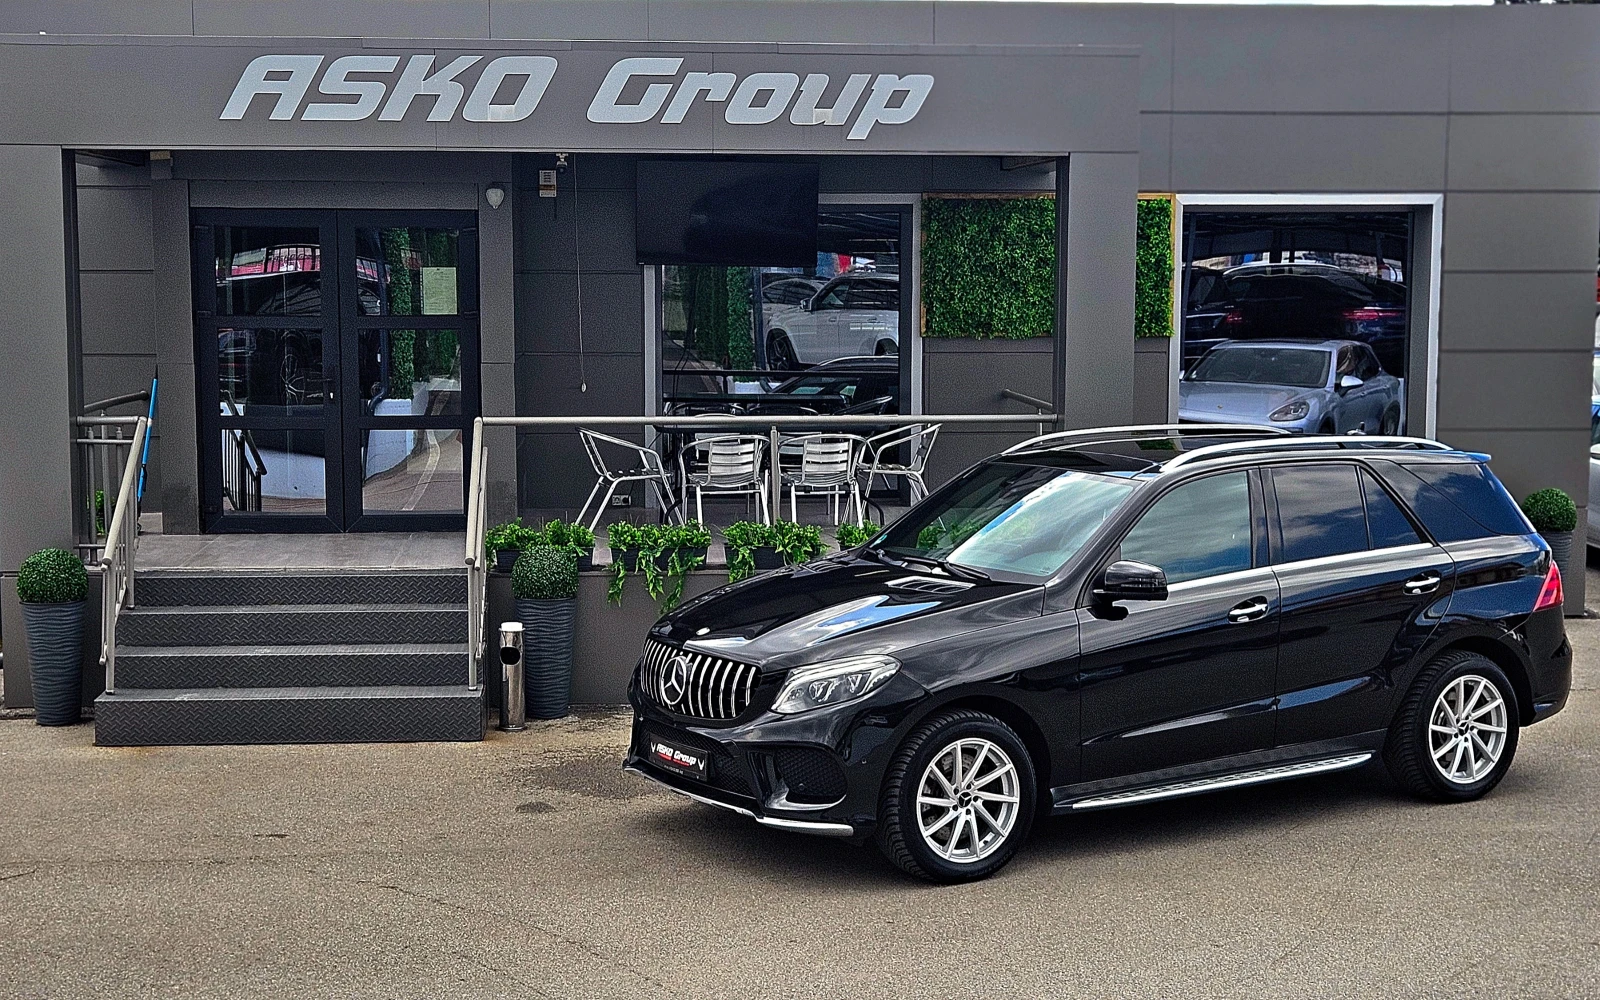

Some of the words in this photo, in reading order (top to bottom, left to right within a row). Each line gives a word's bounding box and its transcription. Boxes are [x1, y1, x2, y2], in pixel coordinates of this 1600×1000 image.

[219, 54, 558, 122] ASKO
[586, 57, 935, 140] Group
[673, 750, 697, 766] Group
